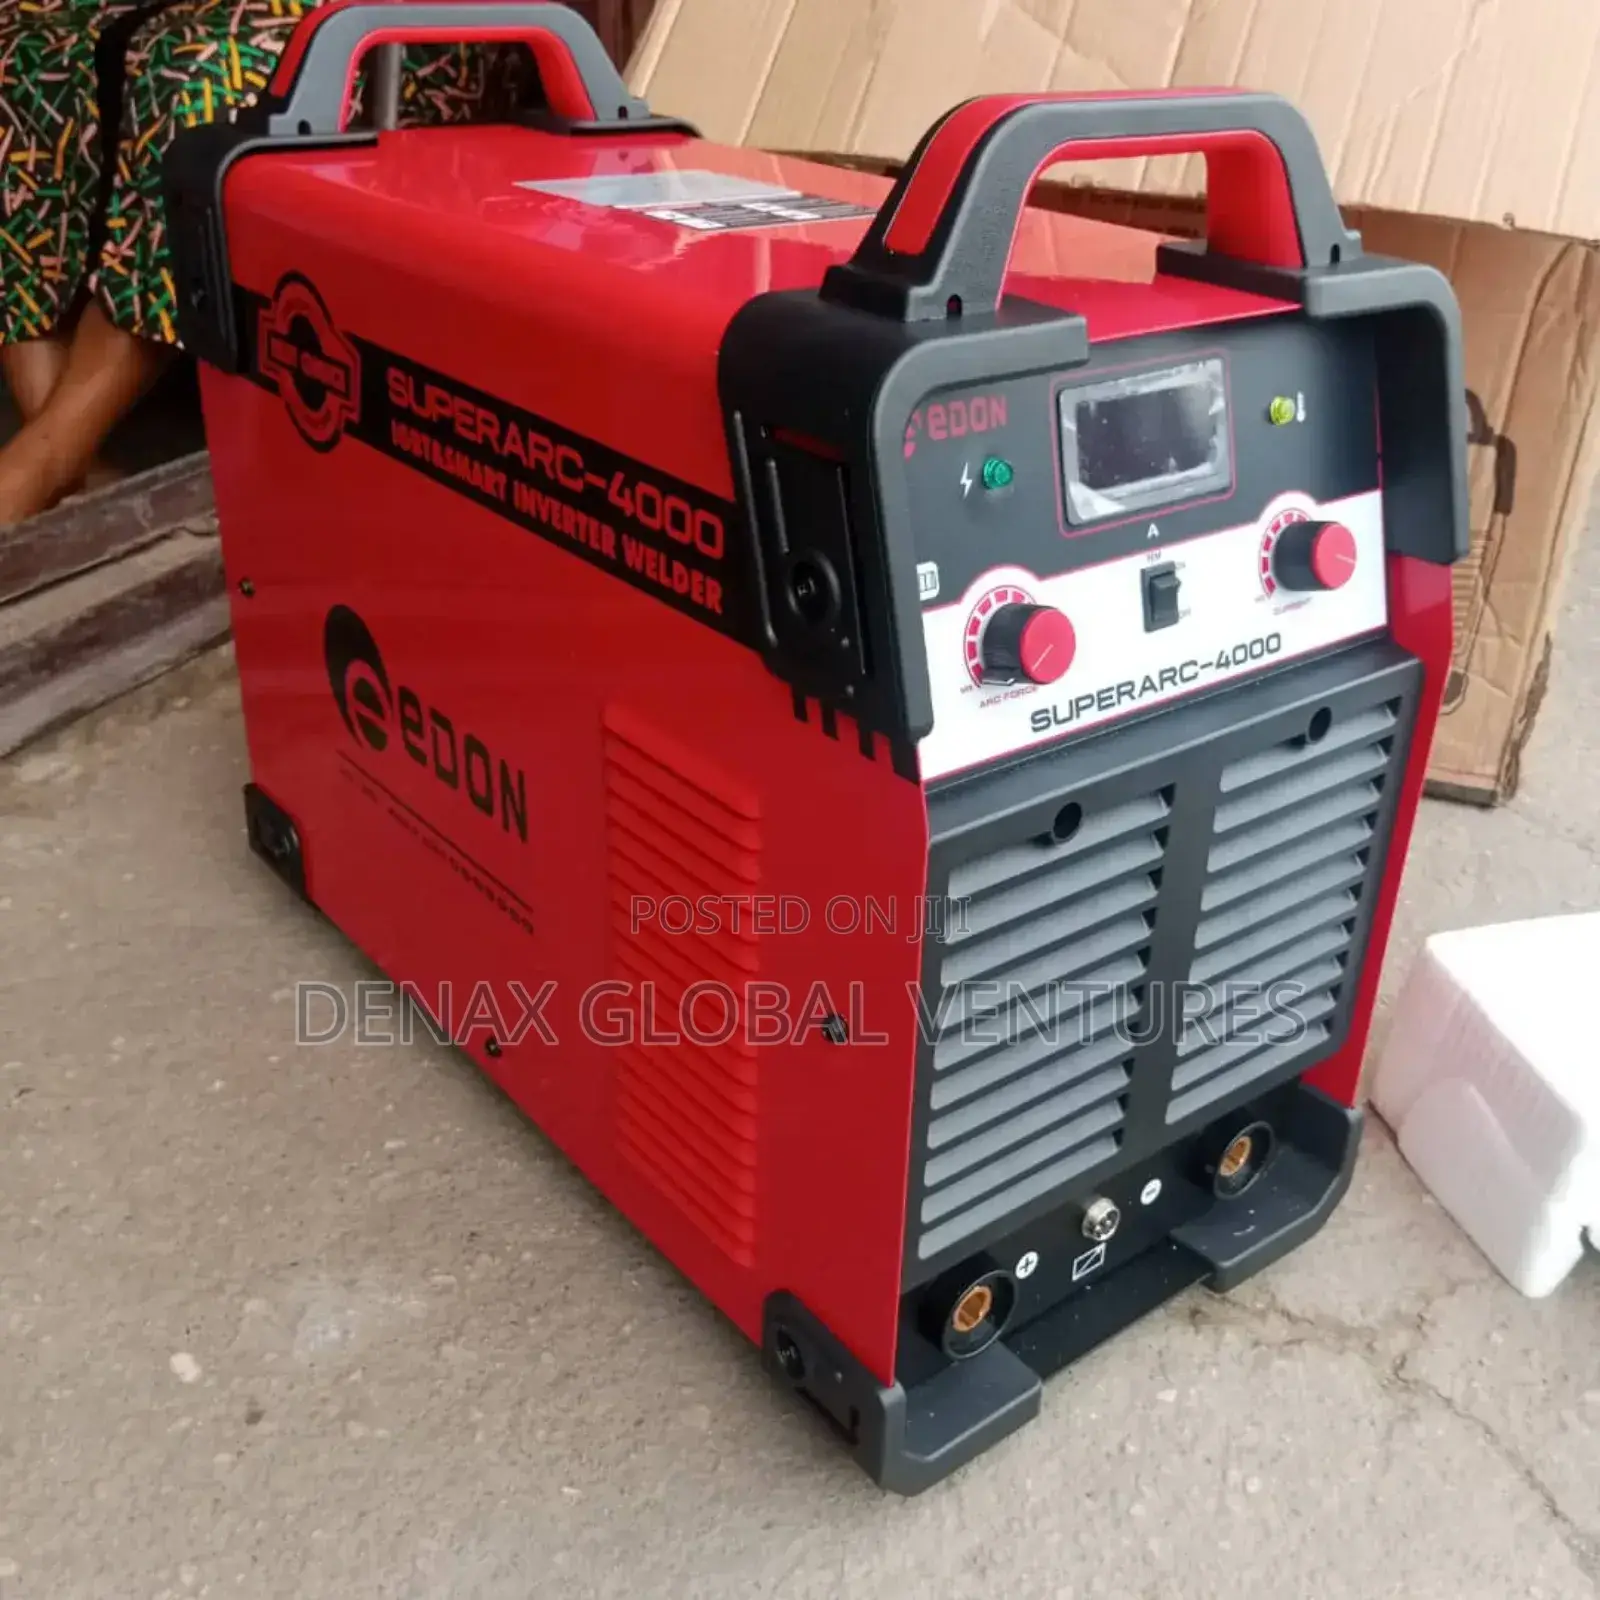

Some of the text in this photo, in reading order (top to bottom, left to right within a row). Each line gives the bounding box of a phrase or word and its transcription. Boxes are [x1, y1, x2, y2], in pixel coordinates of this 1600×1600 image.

[386, 366, 724, 560] SUPERARC-4000
[513, 479, 617, 560] INVERTER
[621, 532, 723, 616] WELDER
[1146, 522, 1160, 539] A
[1030, 632, 1282, 733] SUPERARC-4000
